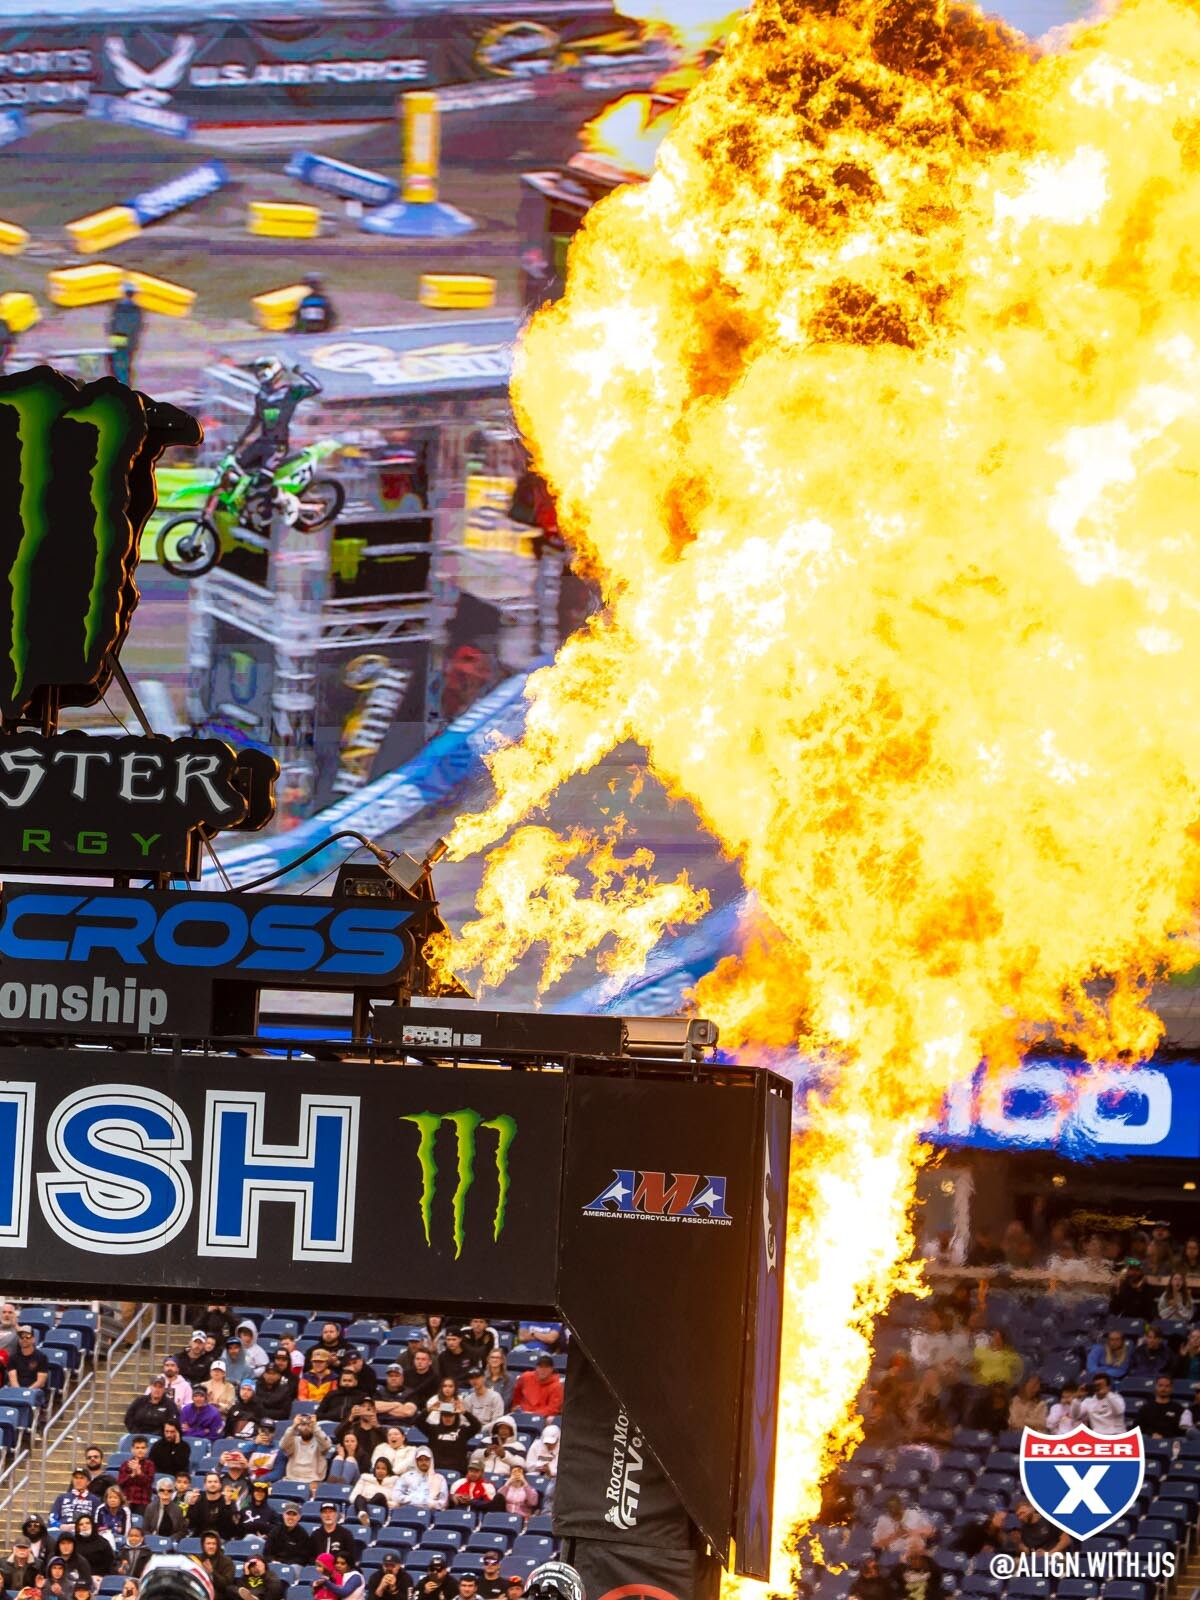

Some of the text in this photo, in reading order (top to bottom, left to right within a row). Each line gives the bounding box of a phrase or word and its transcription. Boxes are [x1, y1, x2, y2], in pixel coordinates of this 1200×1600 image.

[581, 1169, 733, 1219] AMA
[583, 1210, 732, 1226] AMERICAN MOTORCYCLIST ASSOCIATION
[606, 1447, 625, 1503] ROCKY
